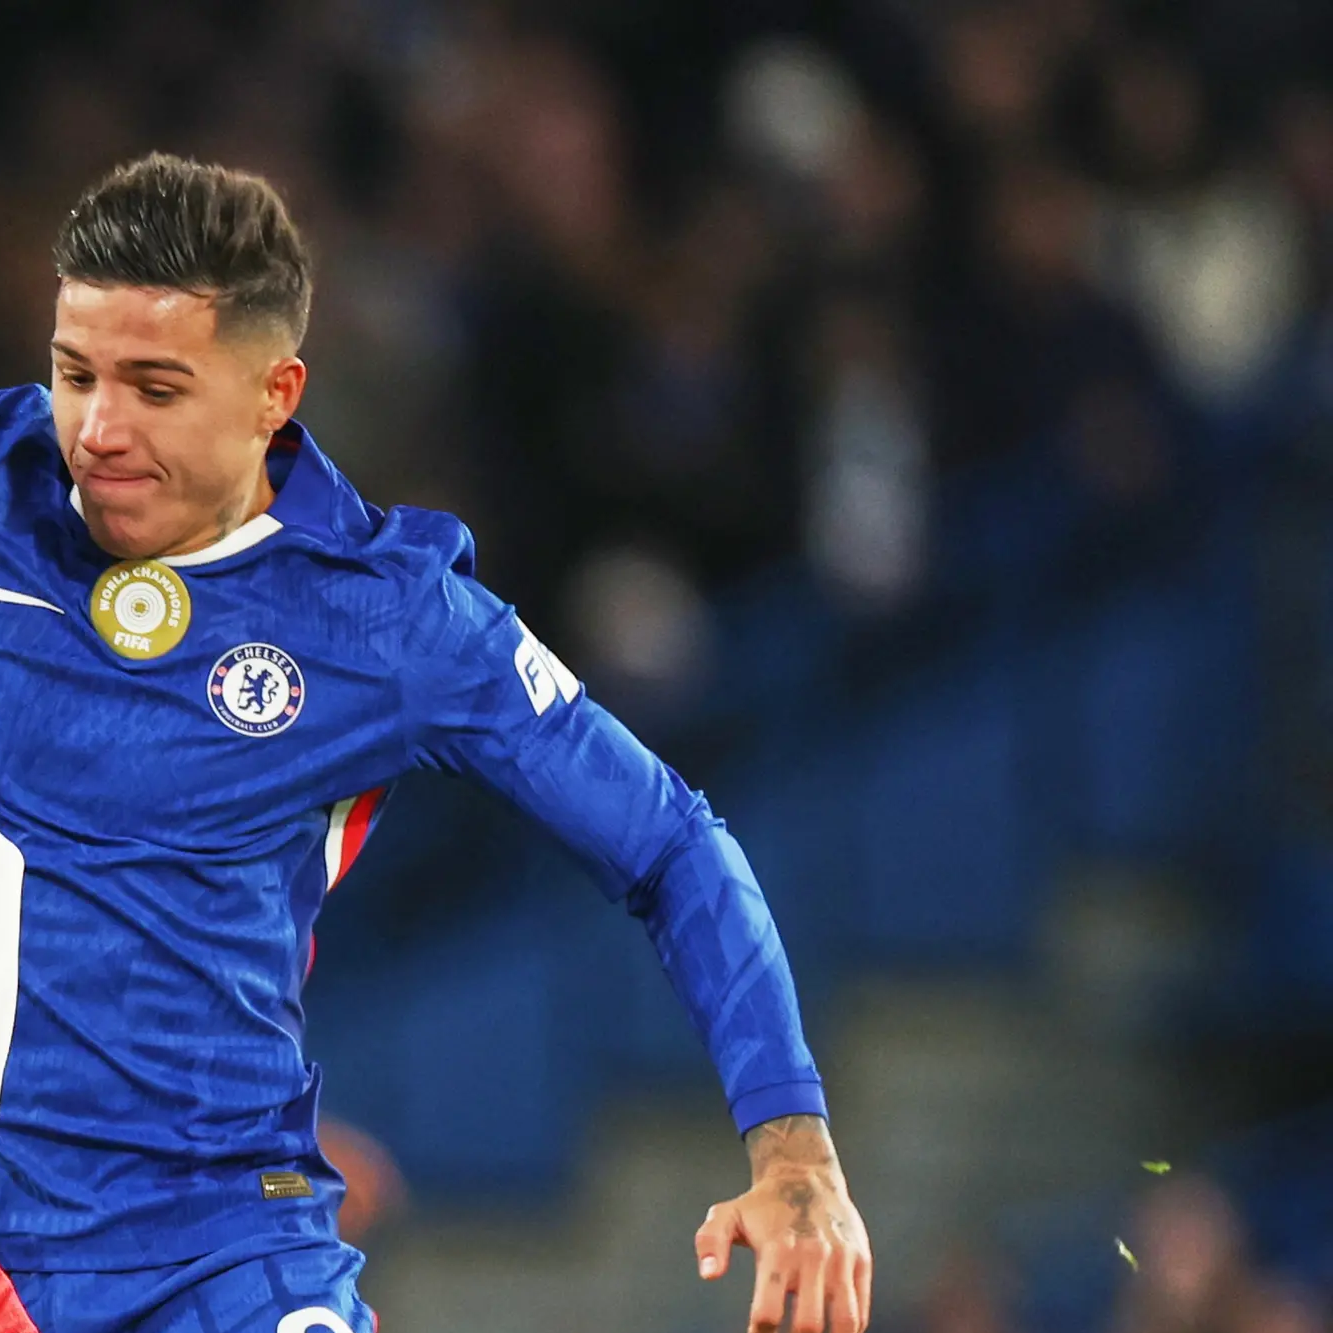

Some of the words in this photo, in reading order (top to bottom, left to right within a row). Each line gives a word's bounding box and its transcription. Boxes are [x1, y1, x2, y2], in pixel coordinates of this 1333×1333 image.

[99, 571, 130, 611] WORLD
[132, 567, 182, 628] CHAMPIONS
[113, 631, 152, 652] FIFA
[234, 646, 293, 676] CHELSEA
